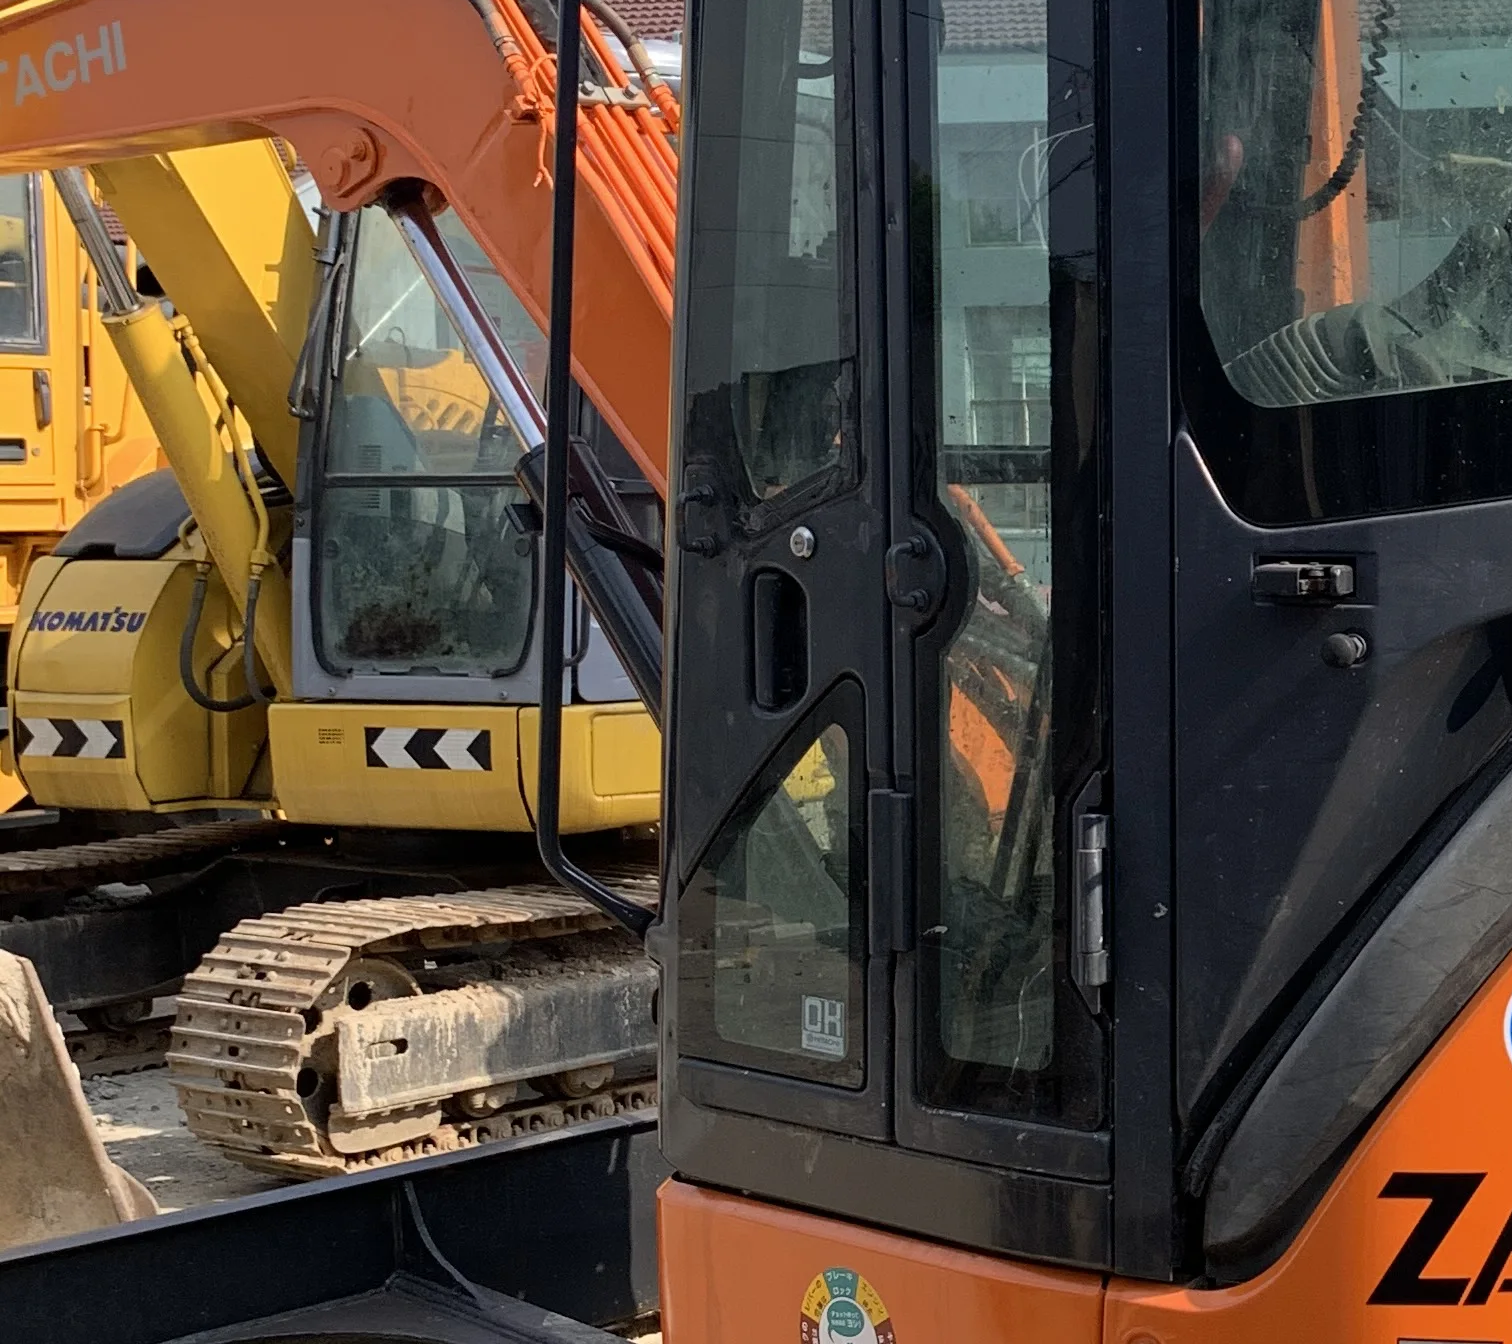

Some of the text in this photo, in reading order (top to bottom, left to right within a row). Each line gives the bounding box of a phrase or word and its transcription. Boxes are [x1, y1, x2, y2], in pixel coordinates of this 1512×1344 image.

[0, 20, 127, 107] ACHI
[28, 606, 147, 633] KOMATSU
[805, 996, 841, 1036] OK
